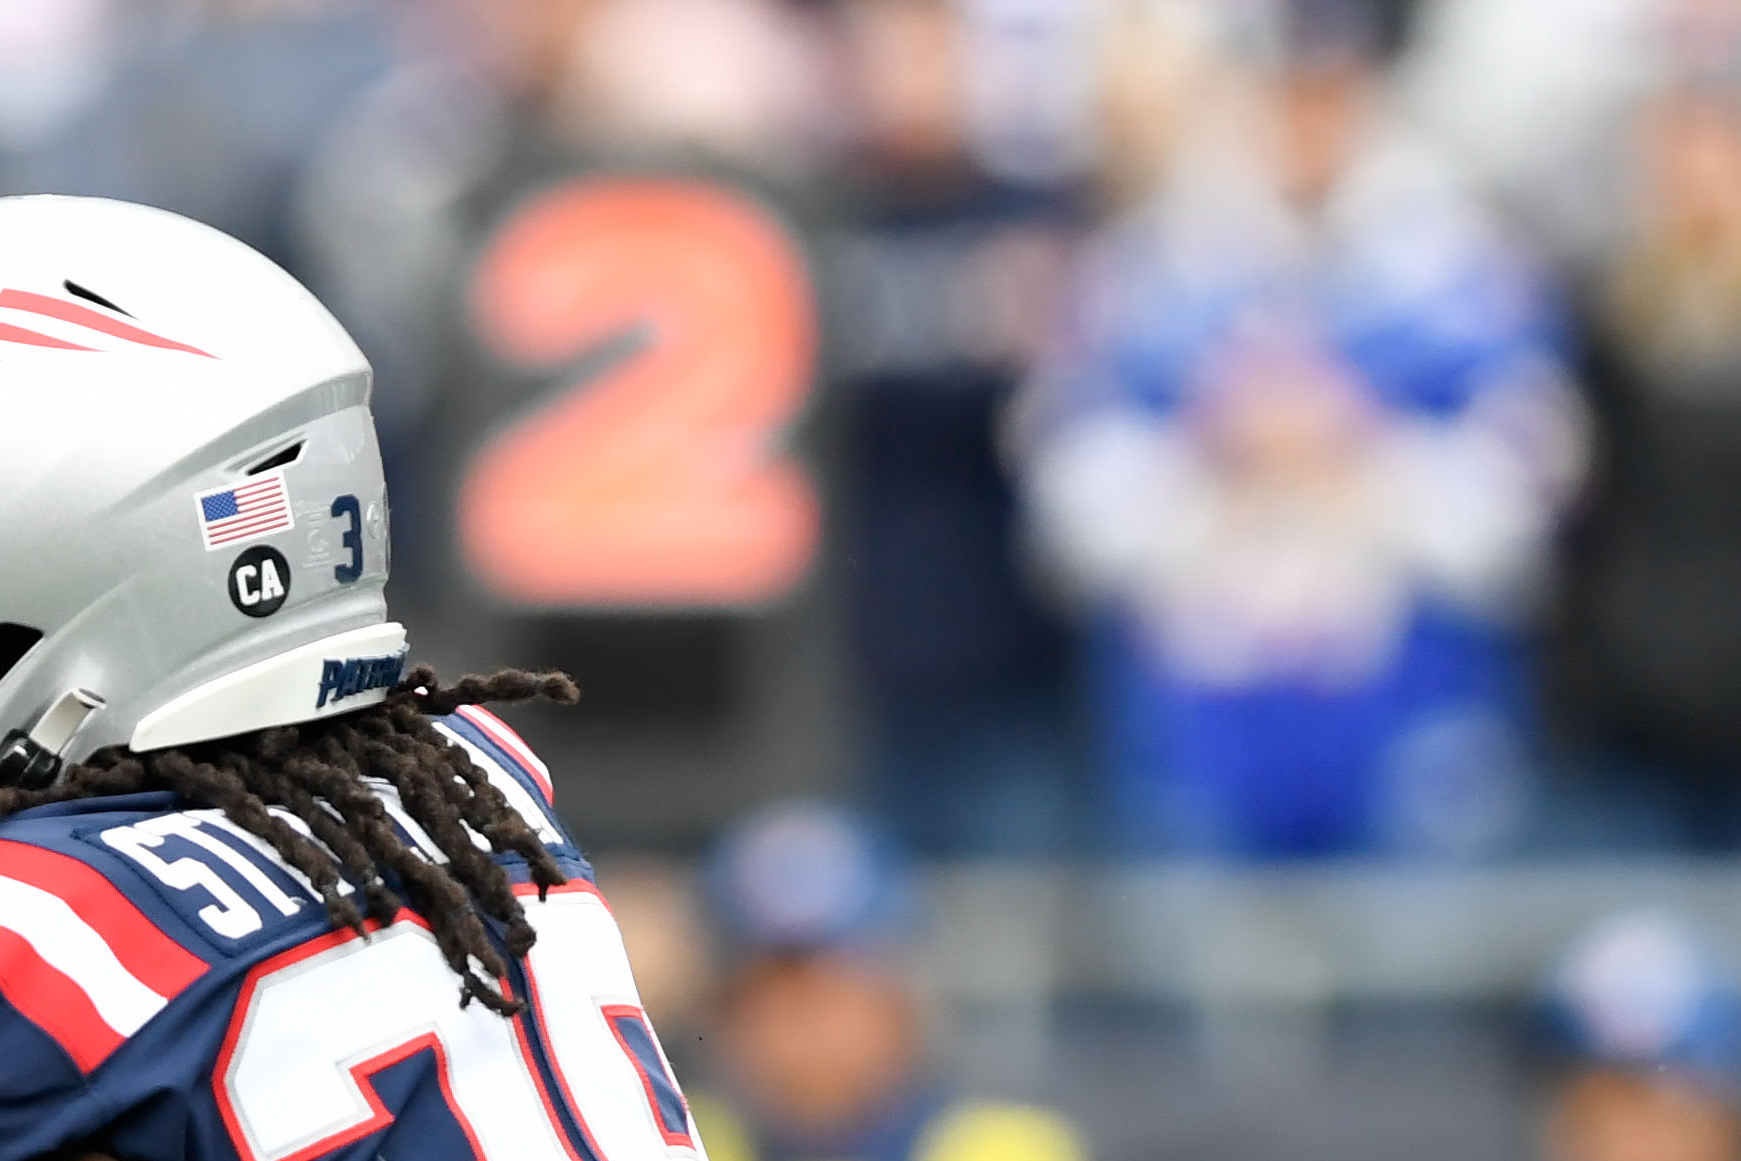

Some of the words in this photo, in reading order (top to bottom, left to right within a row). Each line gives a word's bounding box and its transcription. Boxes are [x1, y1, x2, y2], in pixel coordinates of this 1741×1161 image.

[466, 175, 820, 605] 2
[235, 558, 285, 606] CA
[331, 494, 363, 584] 3
